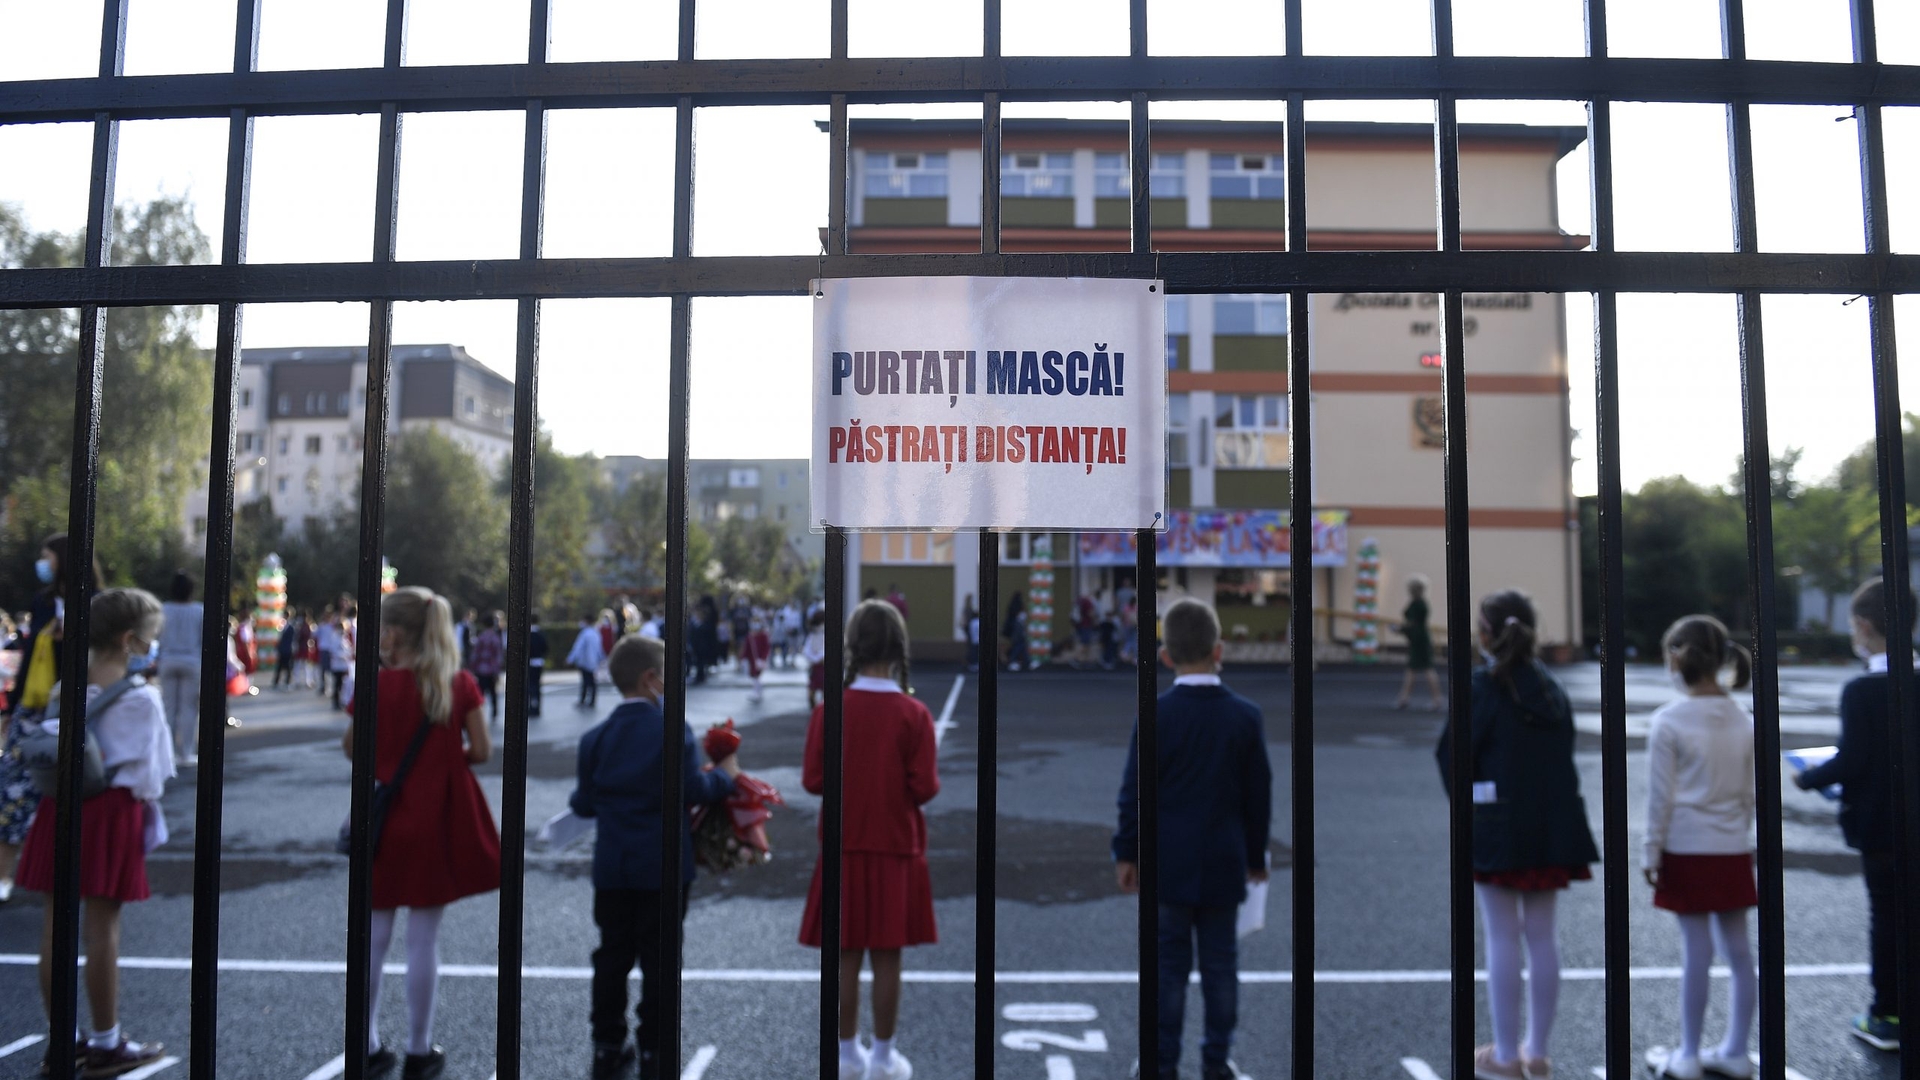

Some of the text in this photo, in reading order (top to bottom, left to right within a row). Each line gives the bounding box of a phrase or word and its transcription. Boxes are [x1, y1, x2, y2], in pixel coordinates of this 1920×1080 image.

[831, 342, 1124, 408] PURTAȚI MASCĂ!
[829, 418, 1126, 475] PĂSTRAȚI DISTANȚA!
